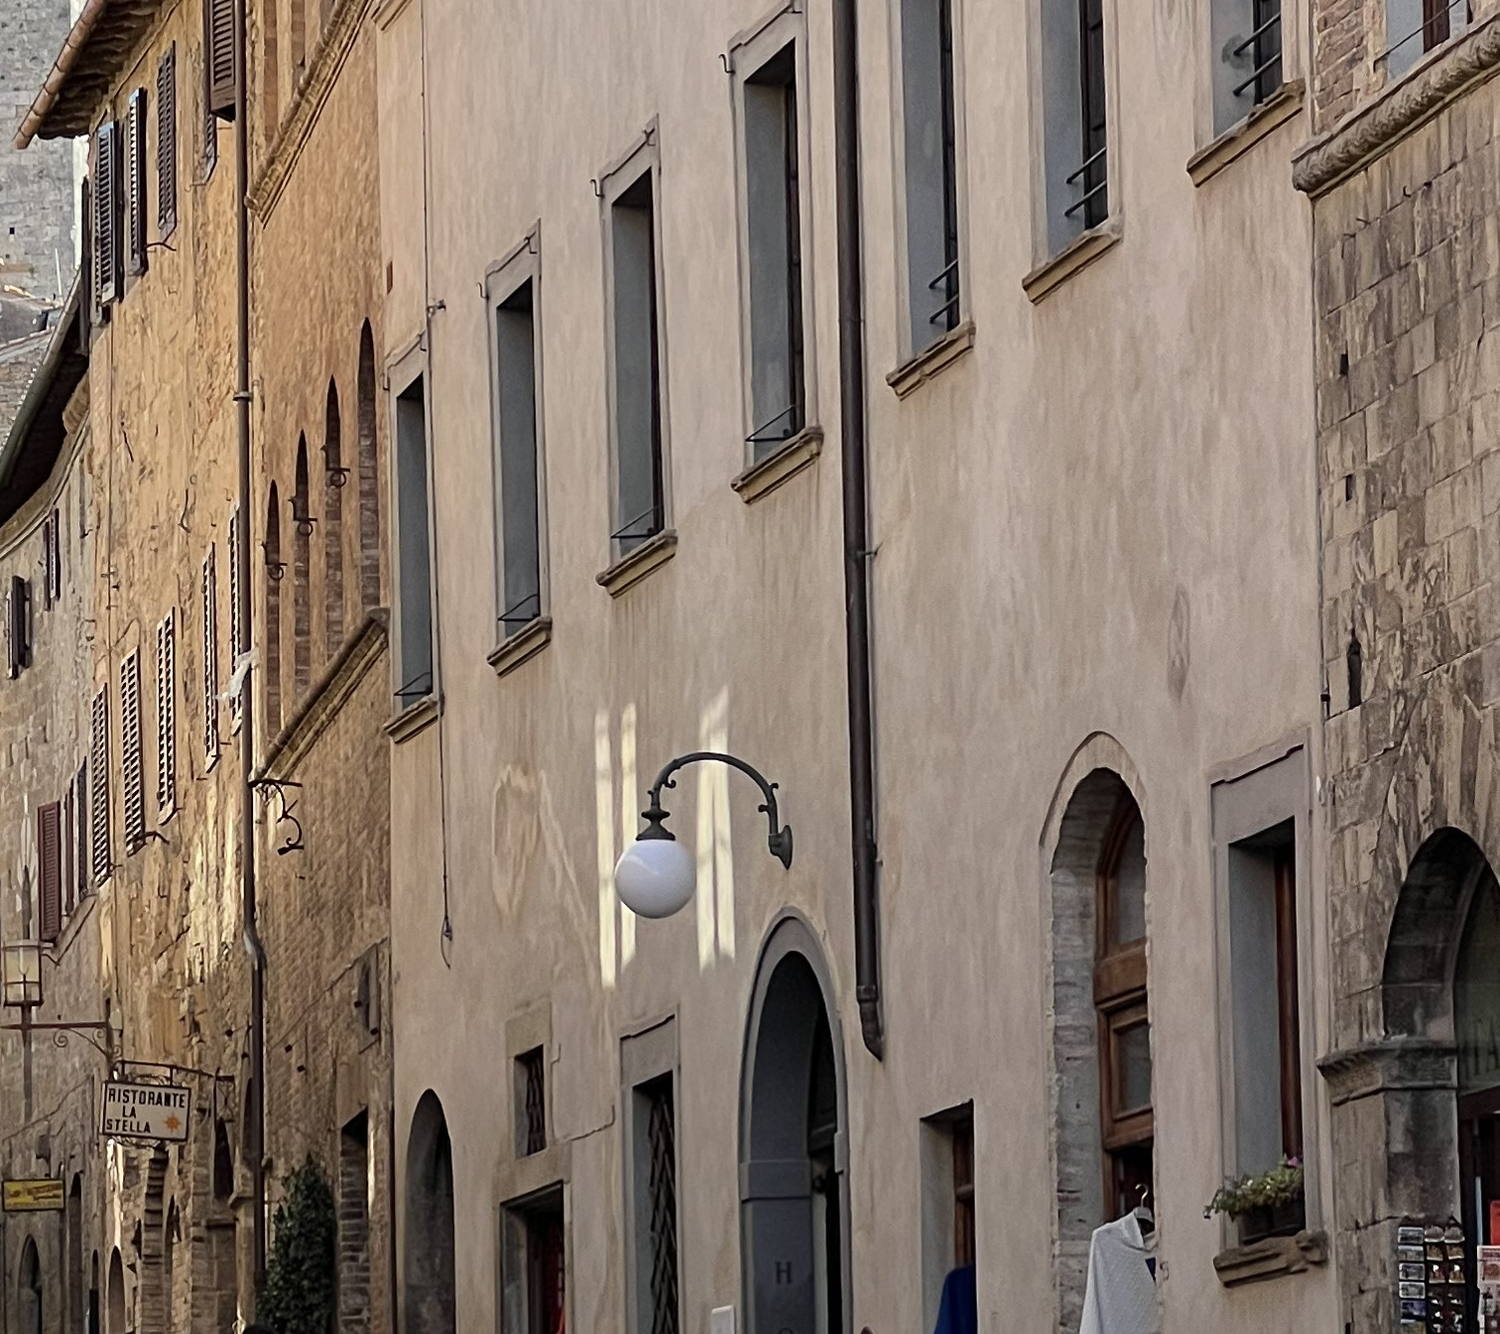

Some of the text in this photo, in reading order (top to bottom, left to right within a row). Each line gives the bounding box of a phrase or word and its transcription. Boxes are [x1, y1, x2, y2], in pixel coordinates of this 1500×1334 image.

[108, 1088, 186, 1108] RISTORANTE
[122, 1105, 137, 1118] LA
[106, 1119, 151, 1133] STELLA
